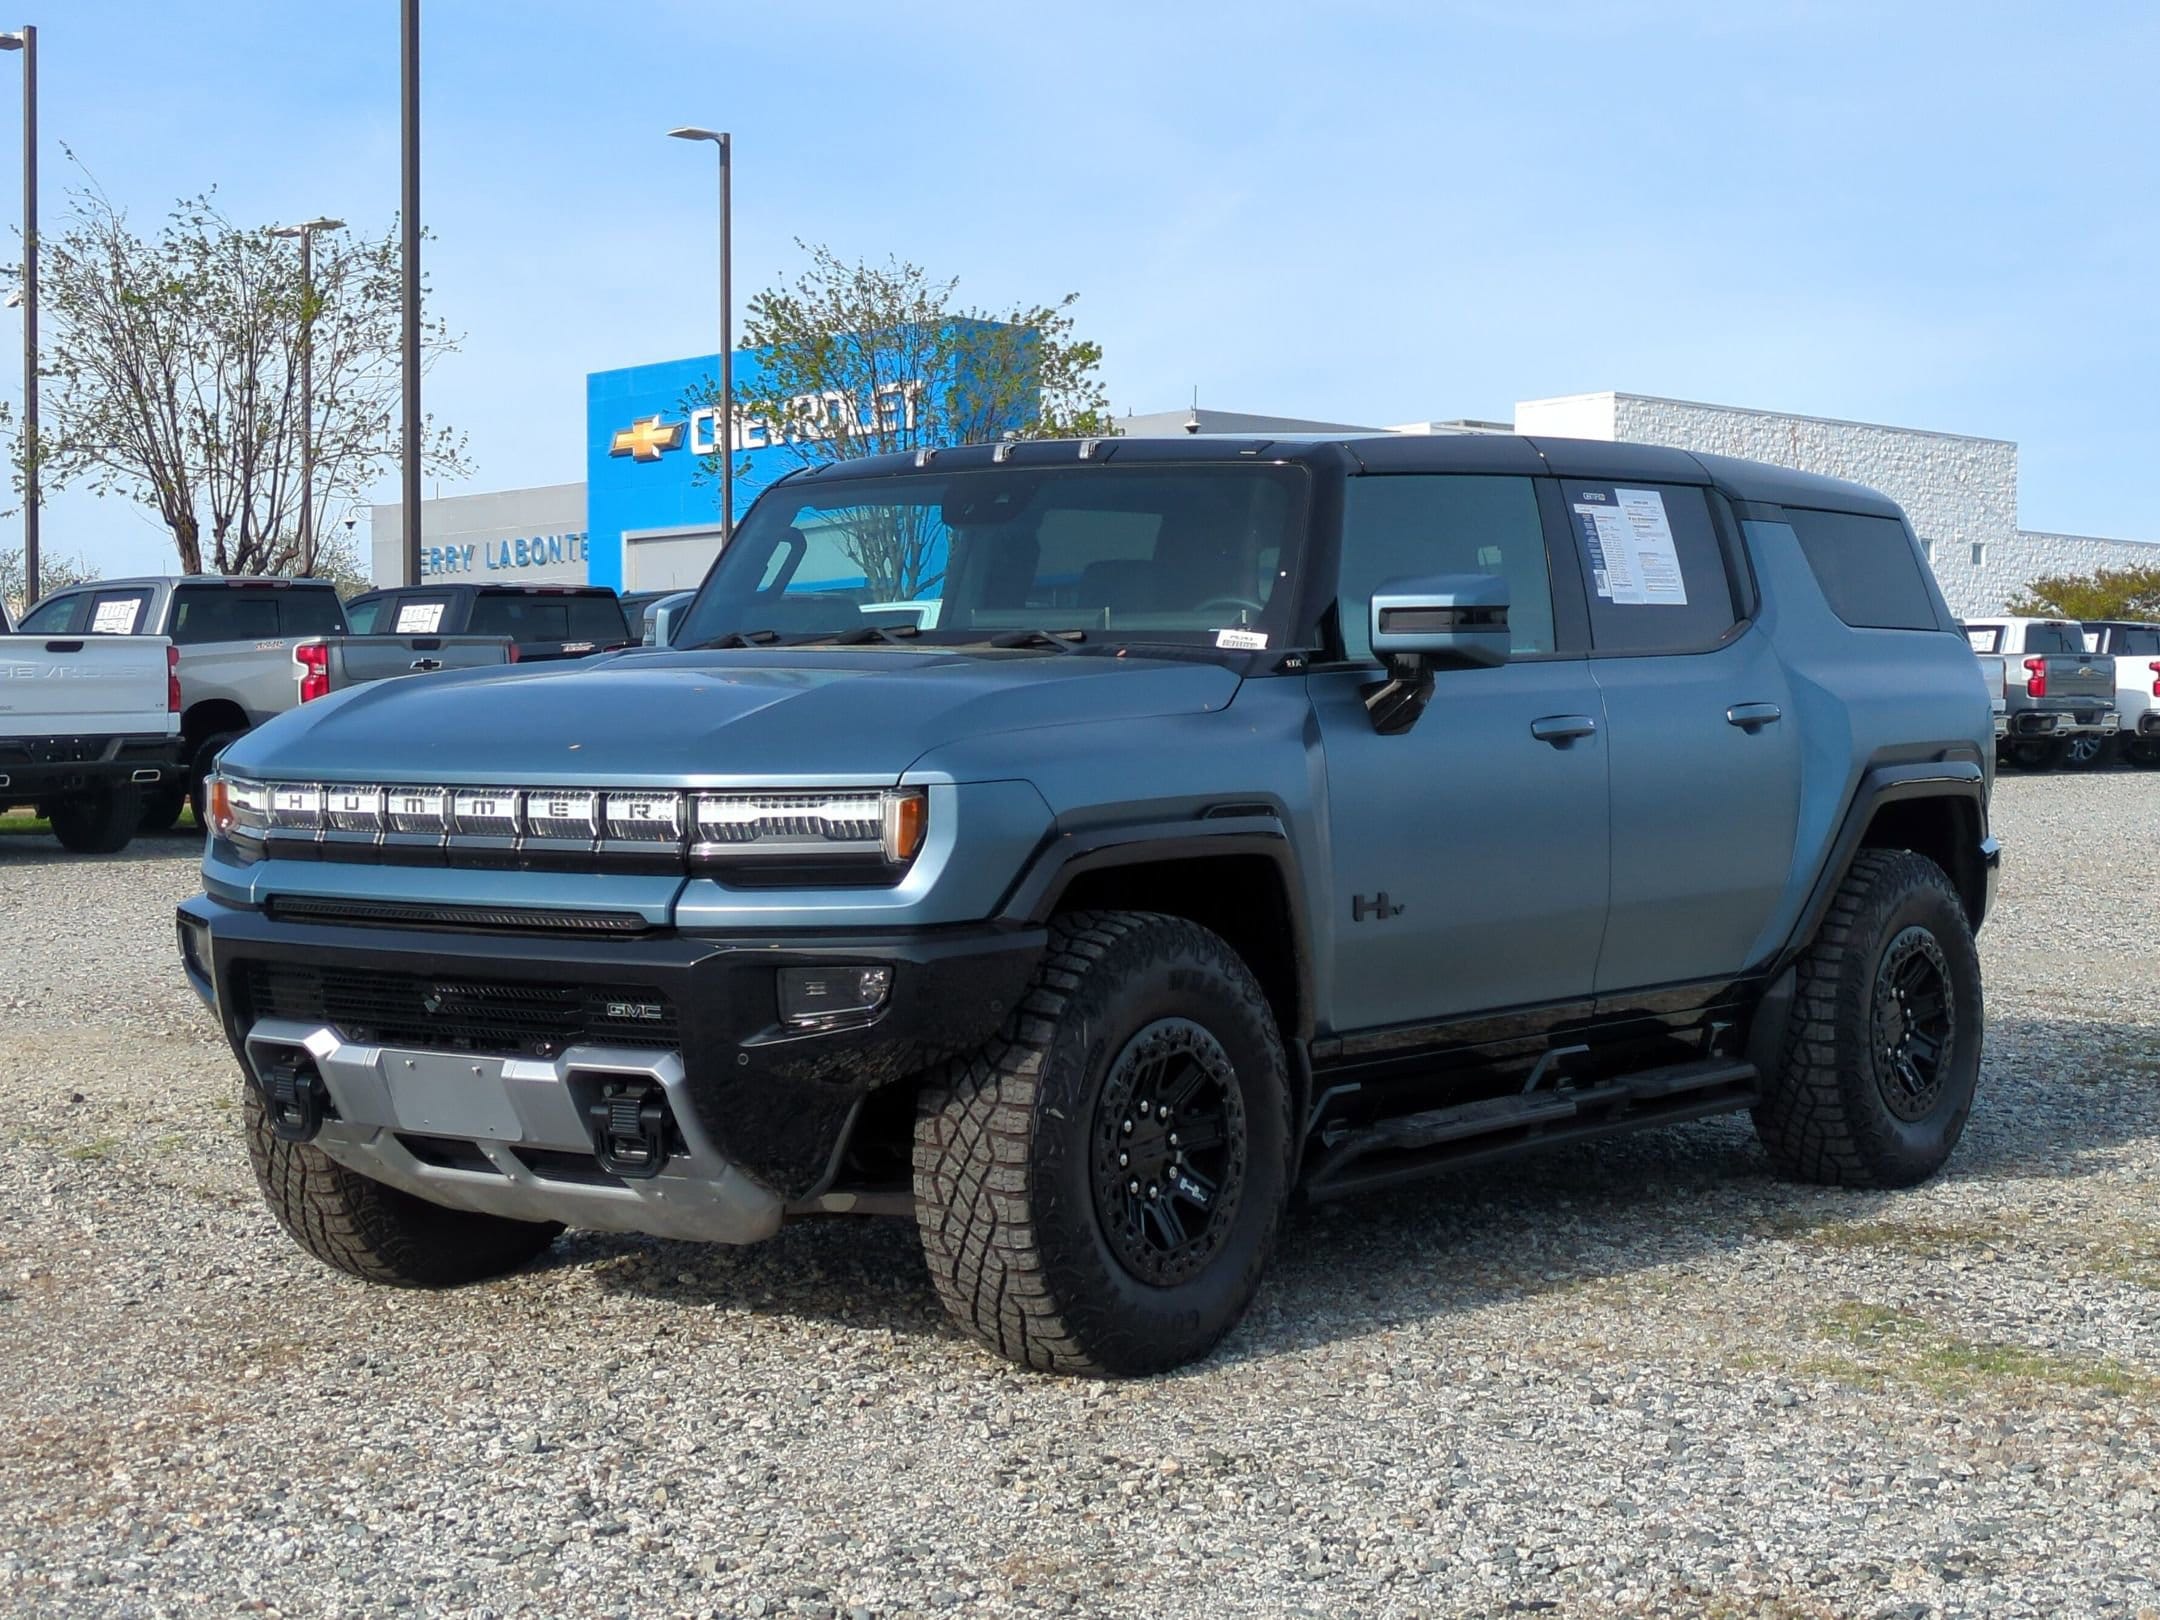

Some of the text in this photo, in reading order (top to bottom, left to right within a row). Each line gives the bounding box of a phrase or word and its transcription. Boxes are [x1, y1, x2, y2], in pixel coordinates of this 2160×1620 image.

[691, 379, 922, 455] CHEVROLET
[421, 532, 589, 576] ERRY LABONTE
[288, 794, 652, 819] HUMMER
[606, 1002, 662, 1020] GMC
